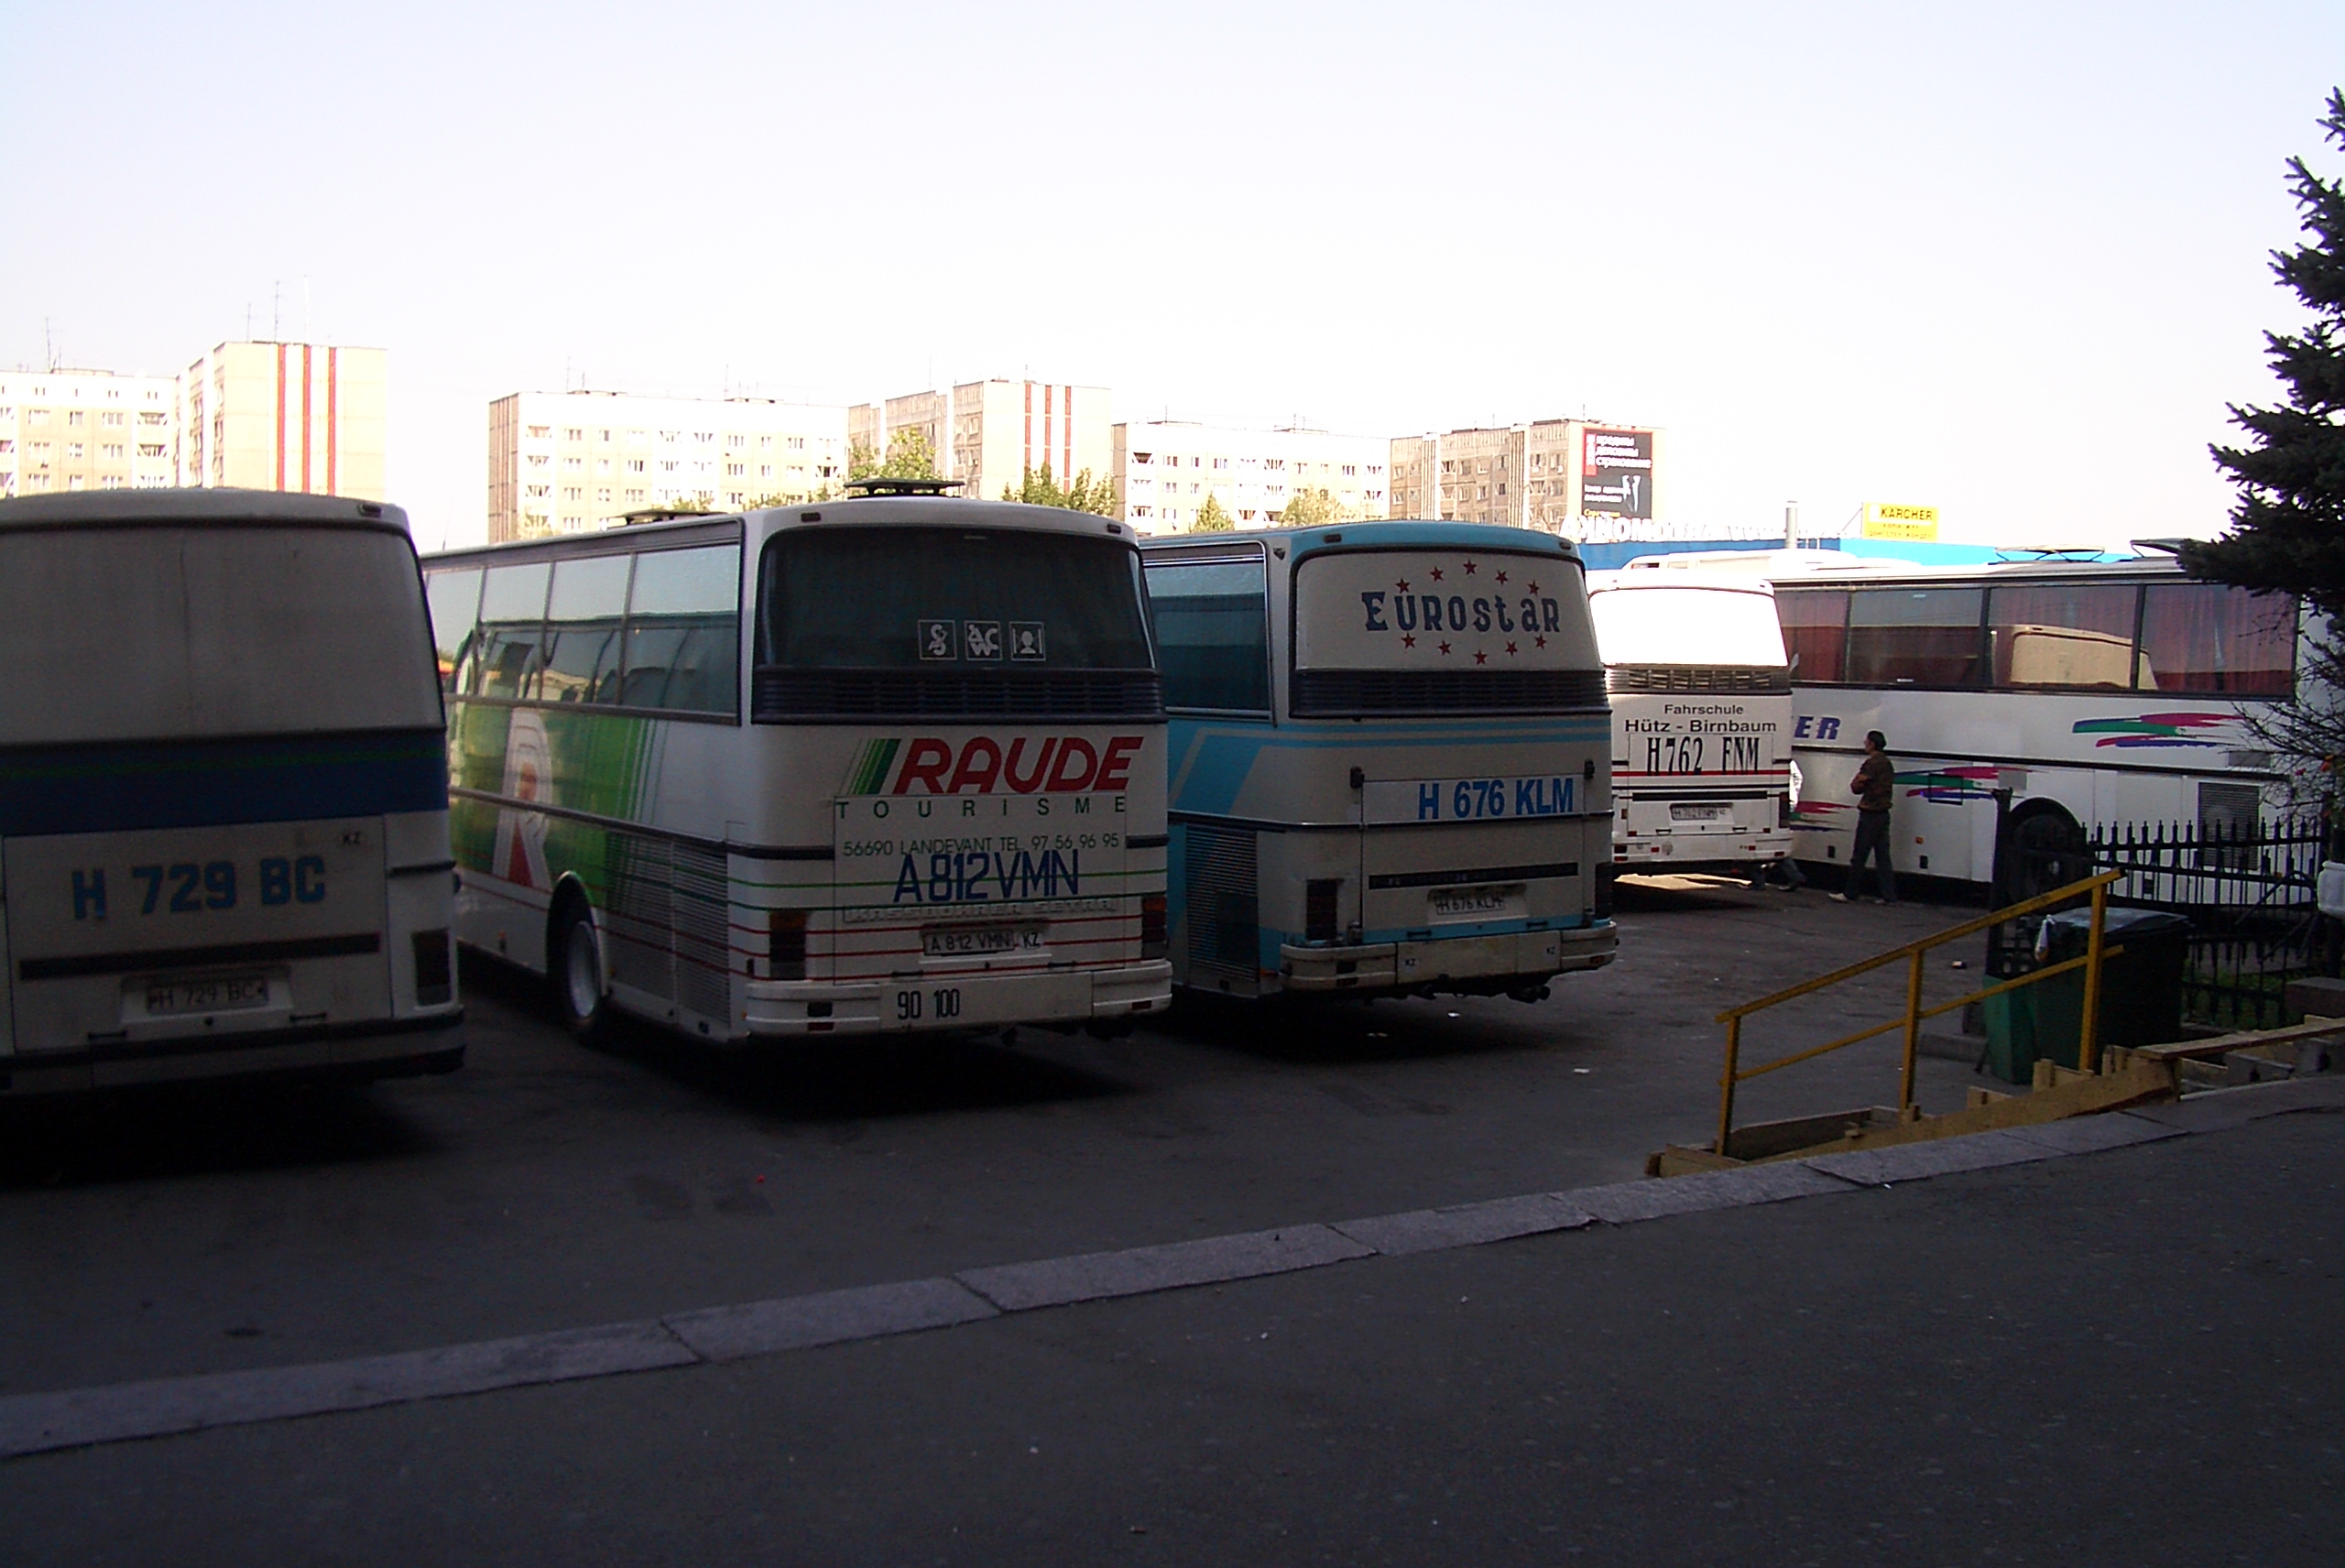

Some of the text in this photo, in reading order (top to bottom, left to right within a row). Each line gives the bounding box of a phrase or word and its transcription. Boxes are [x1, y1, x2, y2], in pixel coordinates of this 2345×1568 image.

[1664, 704, 1743, 714] Fahrschule
[1625, 720, 1670, 733] Hütz
[1690, 720, 1776, 733] Birnbaum
[1793, 715, 1840, 740] ER
[892, 736, 1144, 795] RAUDE
[1647, 736, 1760, 776] H 762 FNM
[1418, 778, 1574, 820] H 676 KLM
[342, 831, 362, 846] KZ
[843, 841, 893, 856] 56690
[900, 837, 991, 855] LANDEVANT
[1031, 835, 1049, 850] 97
[1055, 834, 1073, 849] 56
[1079, 833, 1096, 849] 96
[1103, 832, 1120, 847] 95
[71, 855, 326, 920] H 729 BC
[931, 930, 1014, 950] A 812 VMN
[1022, 931, 1041, 948] KZ
[186, 984, 217, 1005] 729
[898, 989, 960, 1019] 90 100
